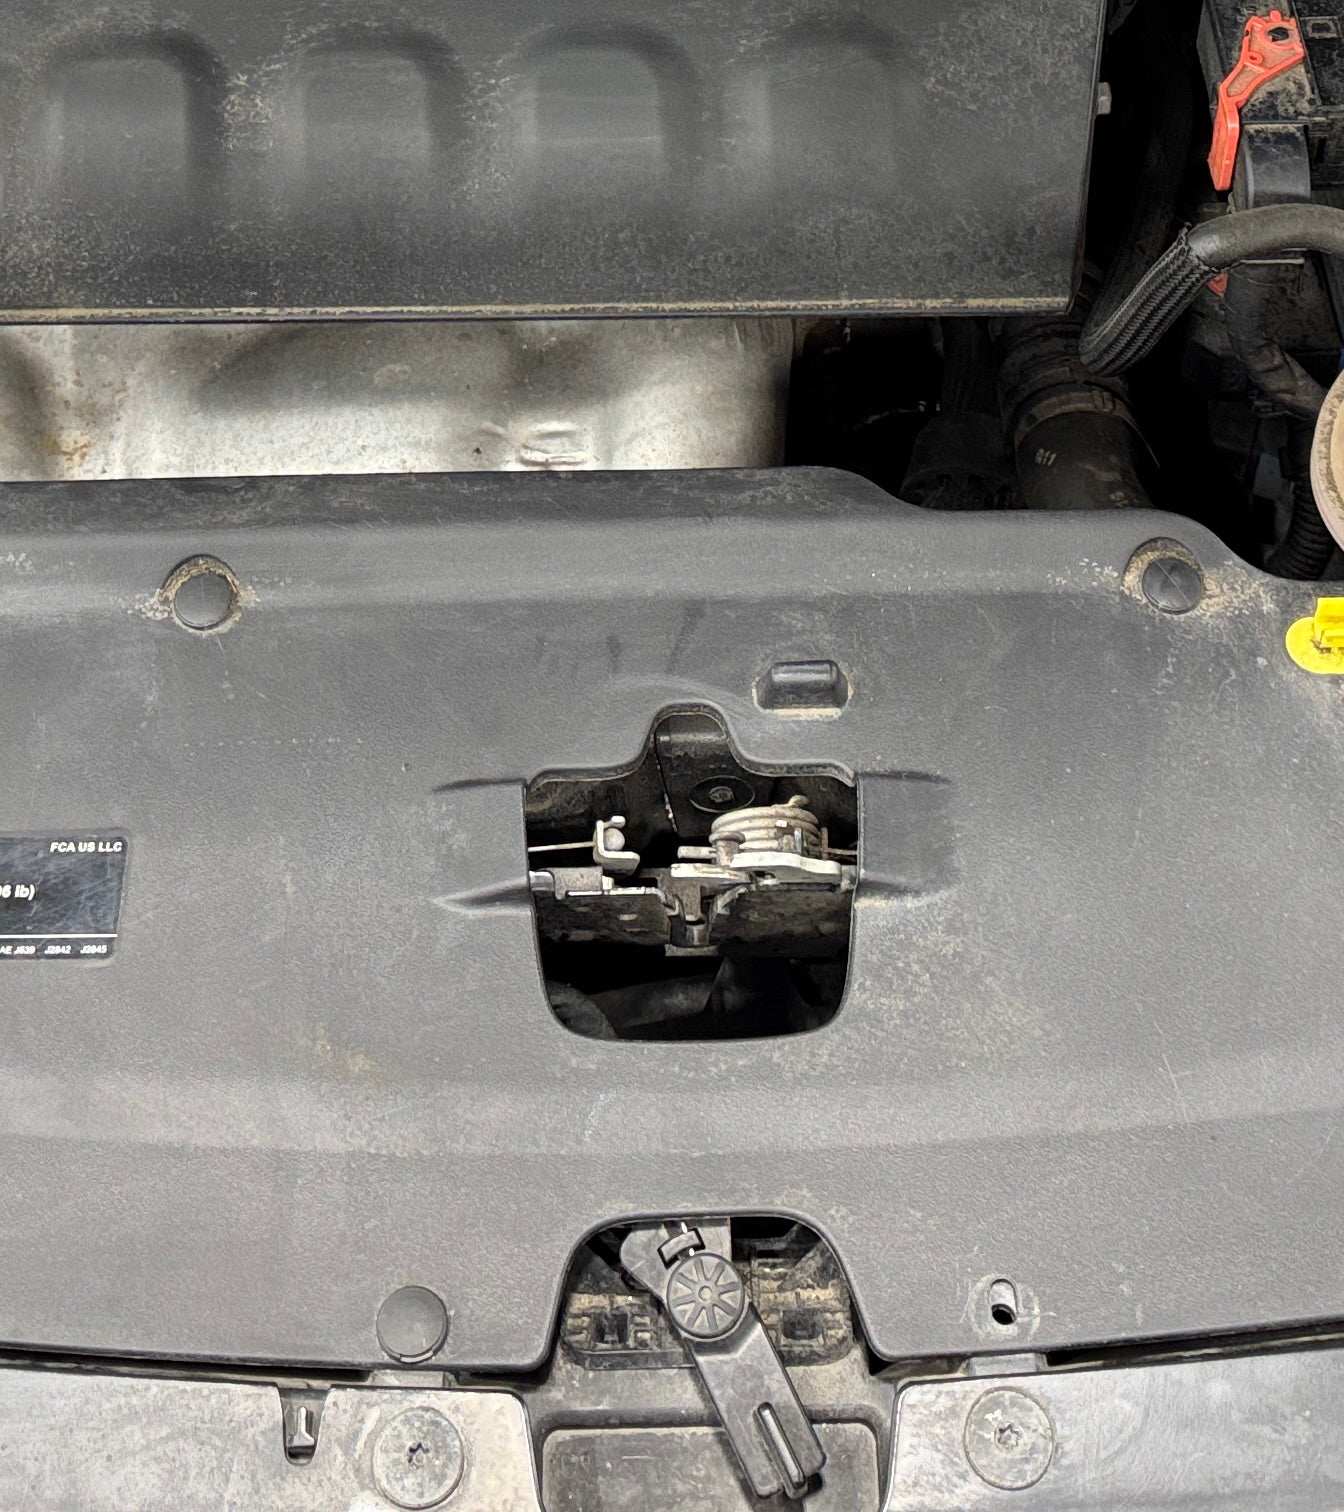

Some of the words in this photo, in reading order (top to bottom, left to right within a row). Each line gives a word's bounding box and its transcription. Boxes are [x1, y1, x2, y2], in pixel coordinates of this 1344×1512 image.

[49, 841, 76, 853] FCA
[78, 841, 96, 852] US
[98, 841, 123, 852] LLC
[14, 884, 35, 900] lb)
